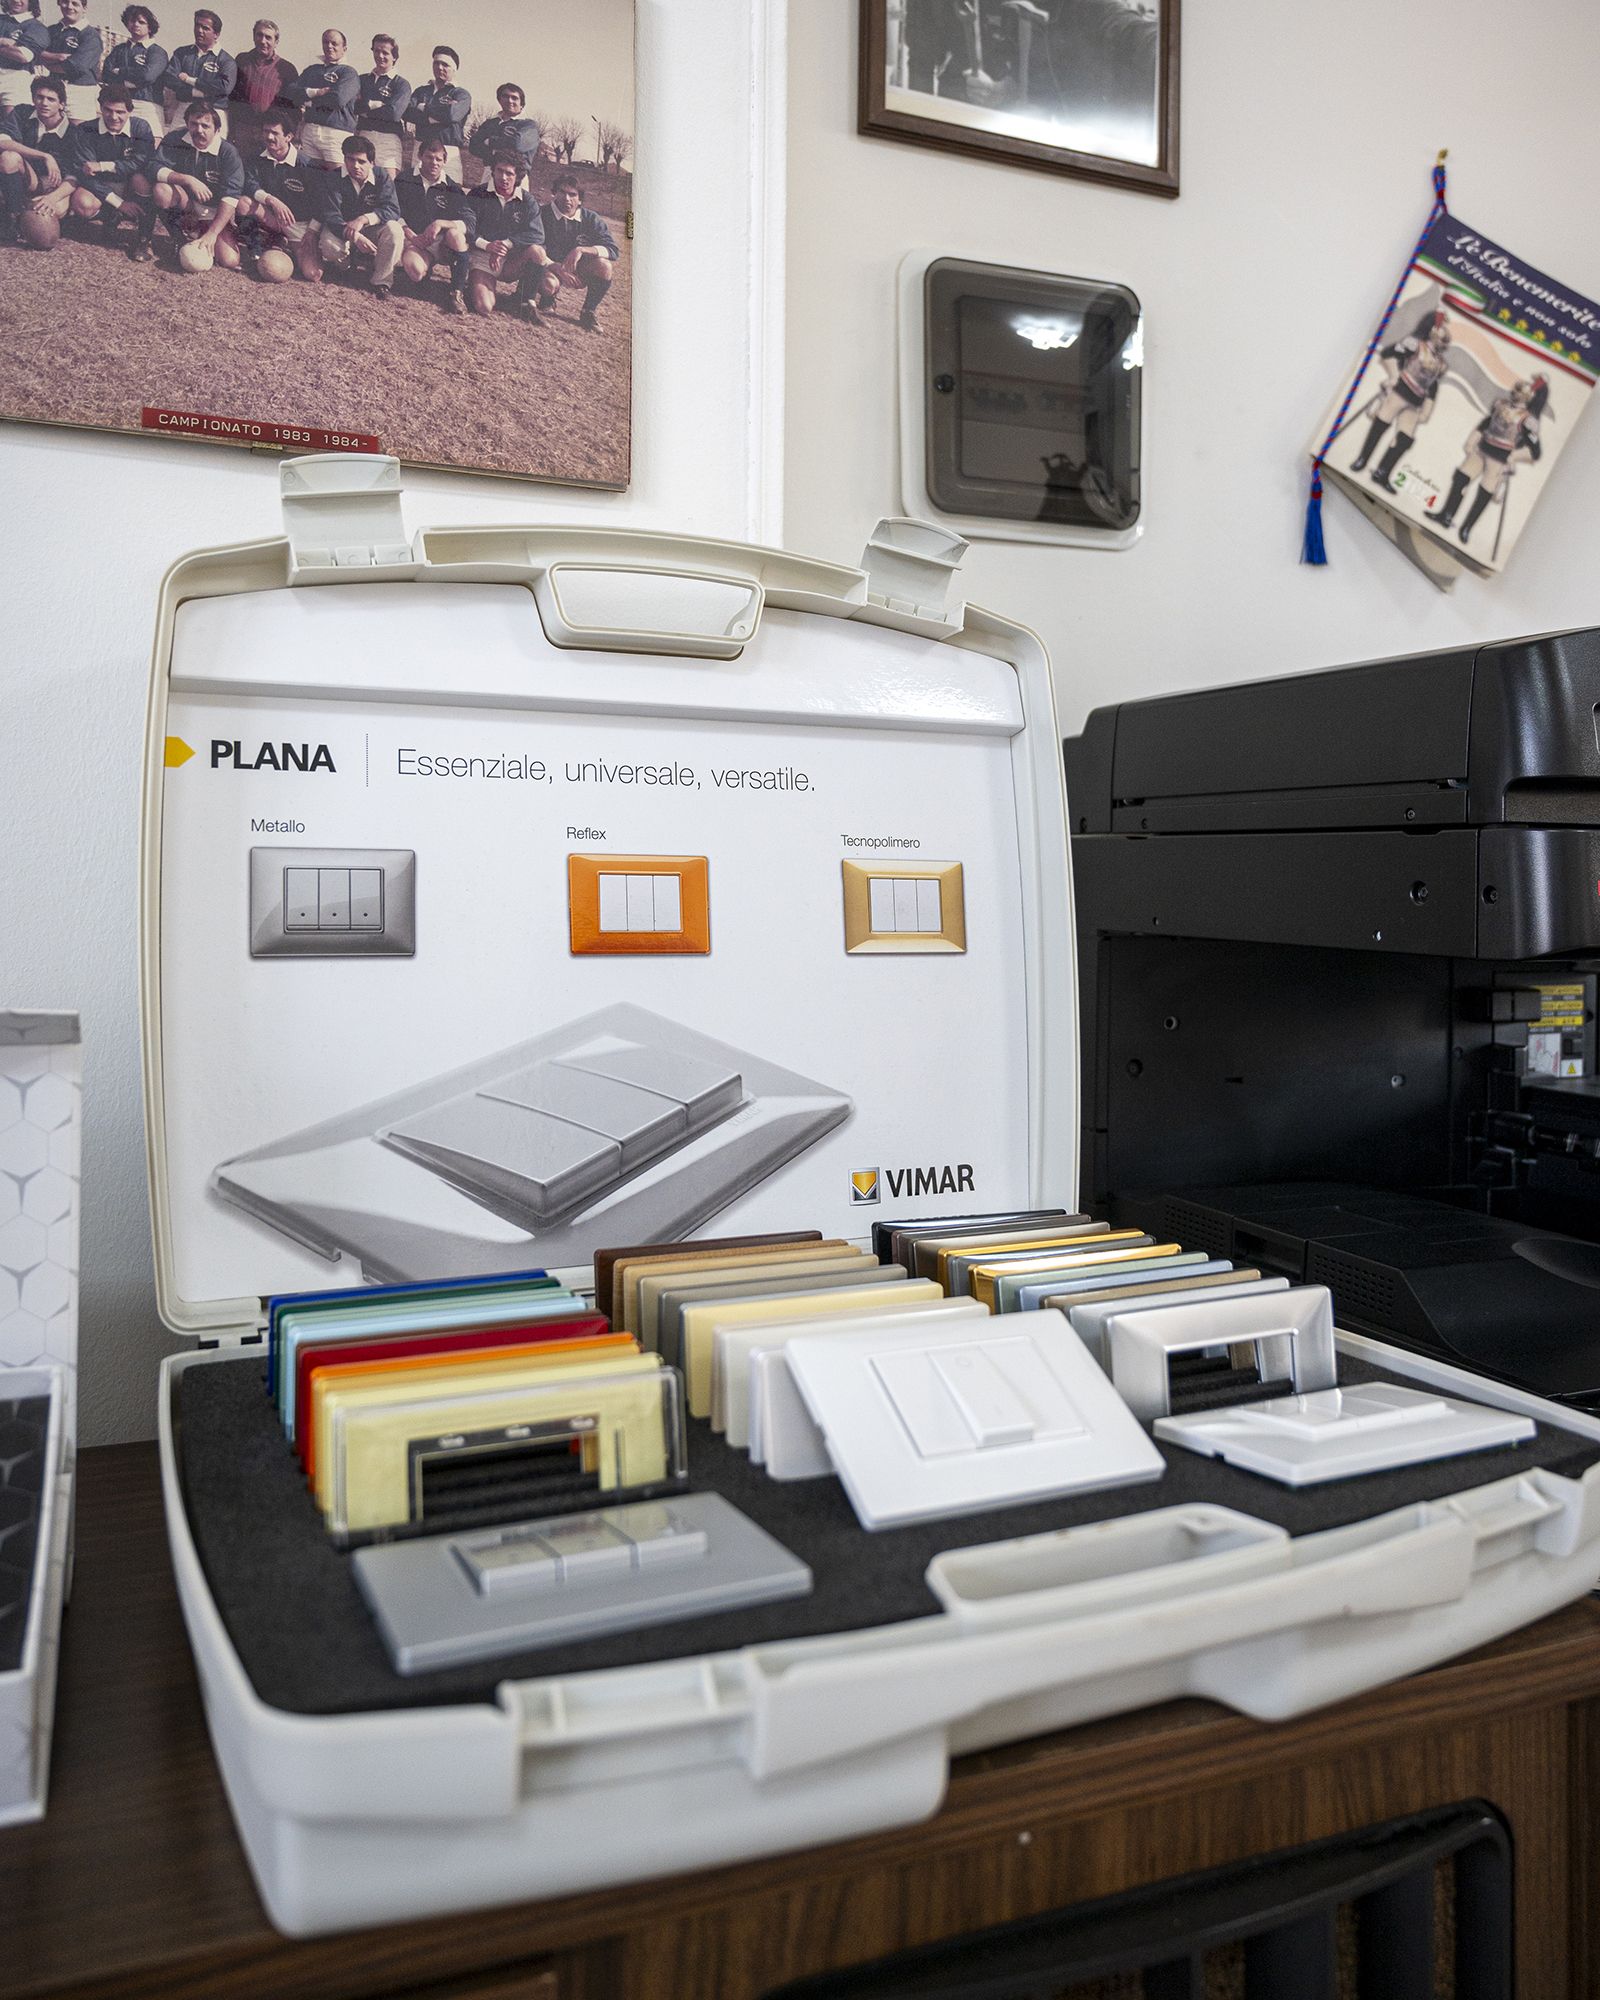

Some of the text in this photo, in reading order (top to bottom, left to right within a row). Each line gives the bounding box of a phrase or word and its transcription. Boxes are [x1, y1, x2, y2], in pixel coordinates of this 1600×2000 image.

[1524, 305, 1556, 327] non
[1557, 325, 1593, 349] solo
[158, 412, 262, 436] CAMPIONATO
[273, 428, 311, 443] 1983
[210, 740, 337, 773] PLANA
[398, 748, 815, 791] Essenziale, universale, versatile.
[251, 818, 306, 833] Metallo
[566, 826, 607, 840] Reflex
[840, 834, 921, 850] Tecnopolimero
[885, 1163, 975, 1198] VIMAR
